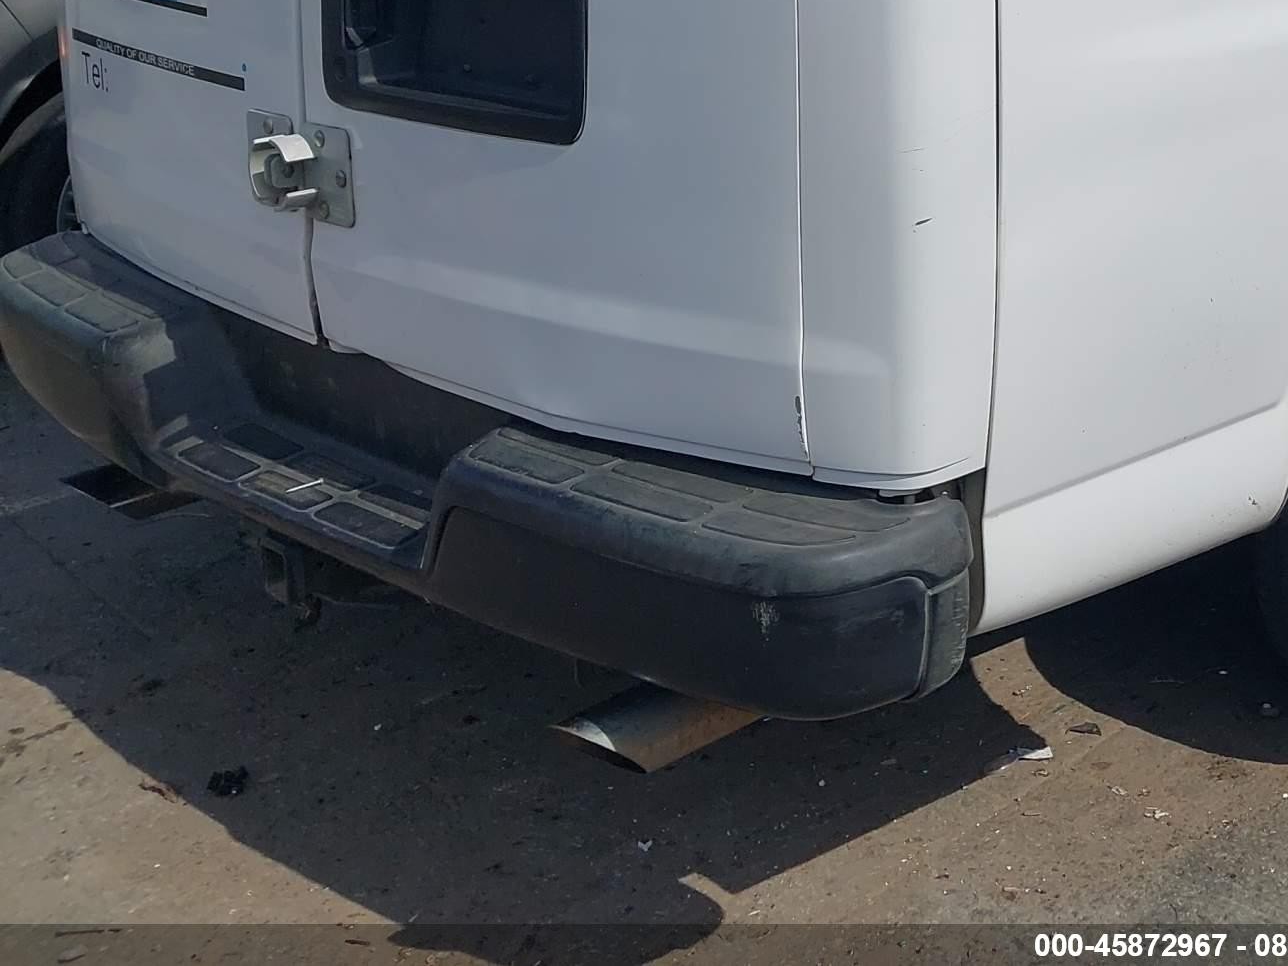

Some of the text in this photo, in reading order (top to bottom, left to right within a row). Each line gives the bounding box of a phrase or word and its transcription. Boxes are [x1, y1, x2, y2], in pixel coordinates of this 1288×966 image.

[81, 50, 109, 93] Tel:
[95, 37, 195, 76] QUALITY OF OUR SERVICE
